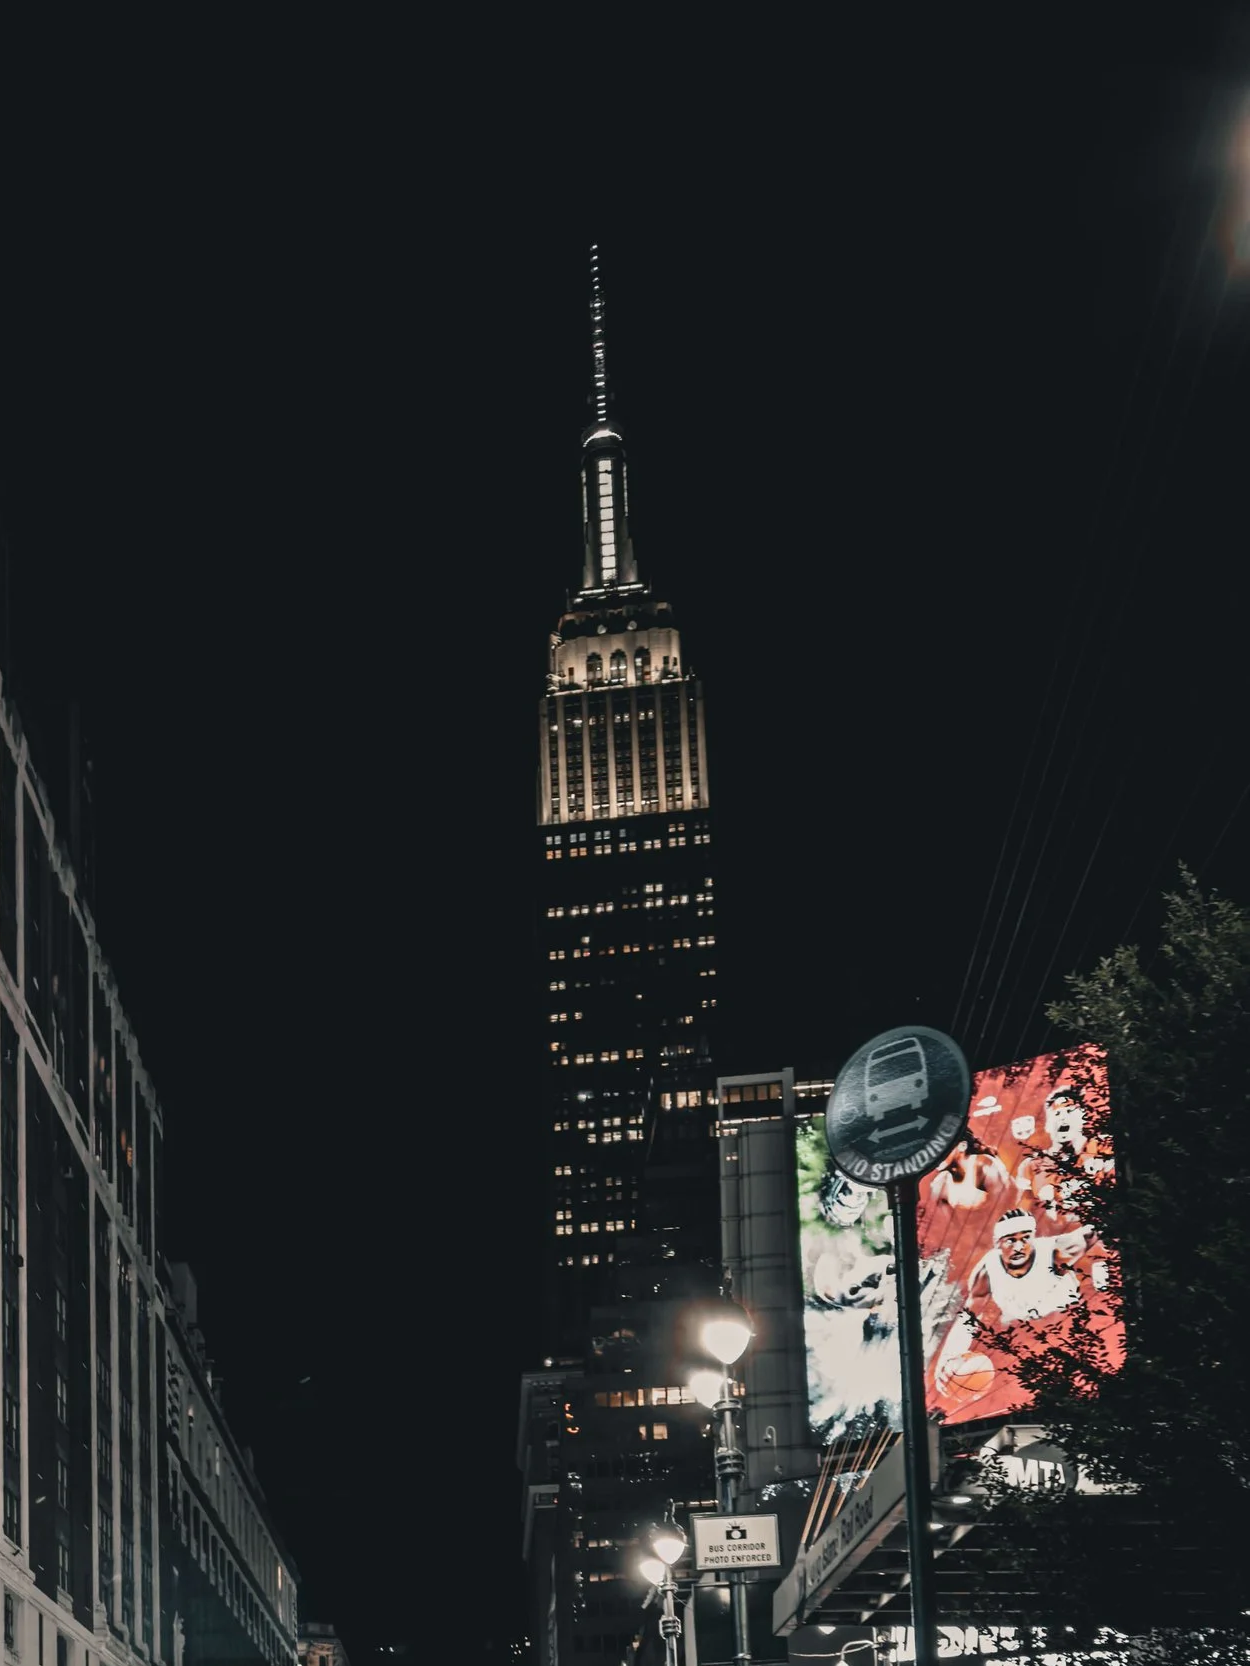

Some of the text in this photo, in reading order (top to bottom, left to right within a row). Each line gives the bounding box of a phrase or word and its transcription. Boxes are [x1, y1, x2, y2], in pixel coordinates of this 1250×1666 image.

[842, 1156, 868, 1176] NO
[870, 1115, 960, 1181] STANDING
[1011, 1457, 1066, 1490] MTA
[855, 1485, 875, 1529] Road
[727, 1542, 766, 1551] CORRIDOR
[732, 1554, 771, 1562] ENFORCED
